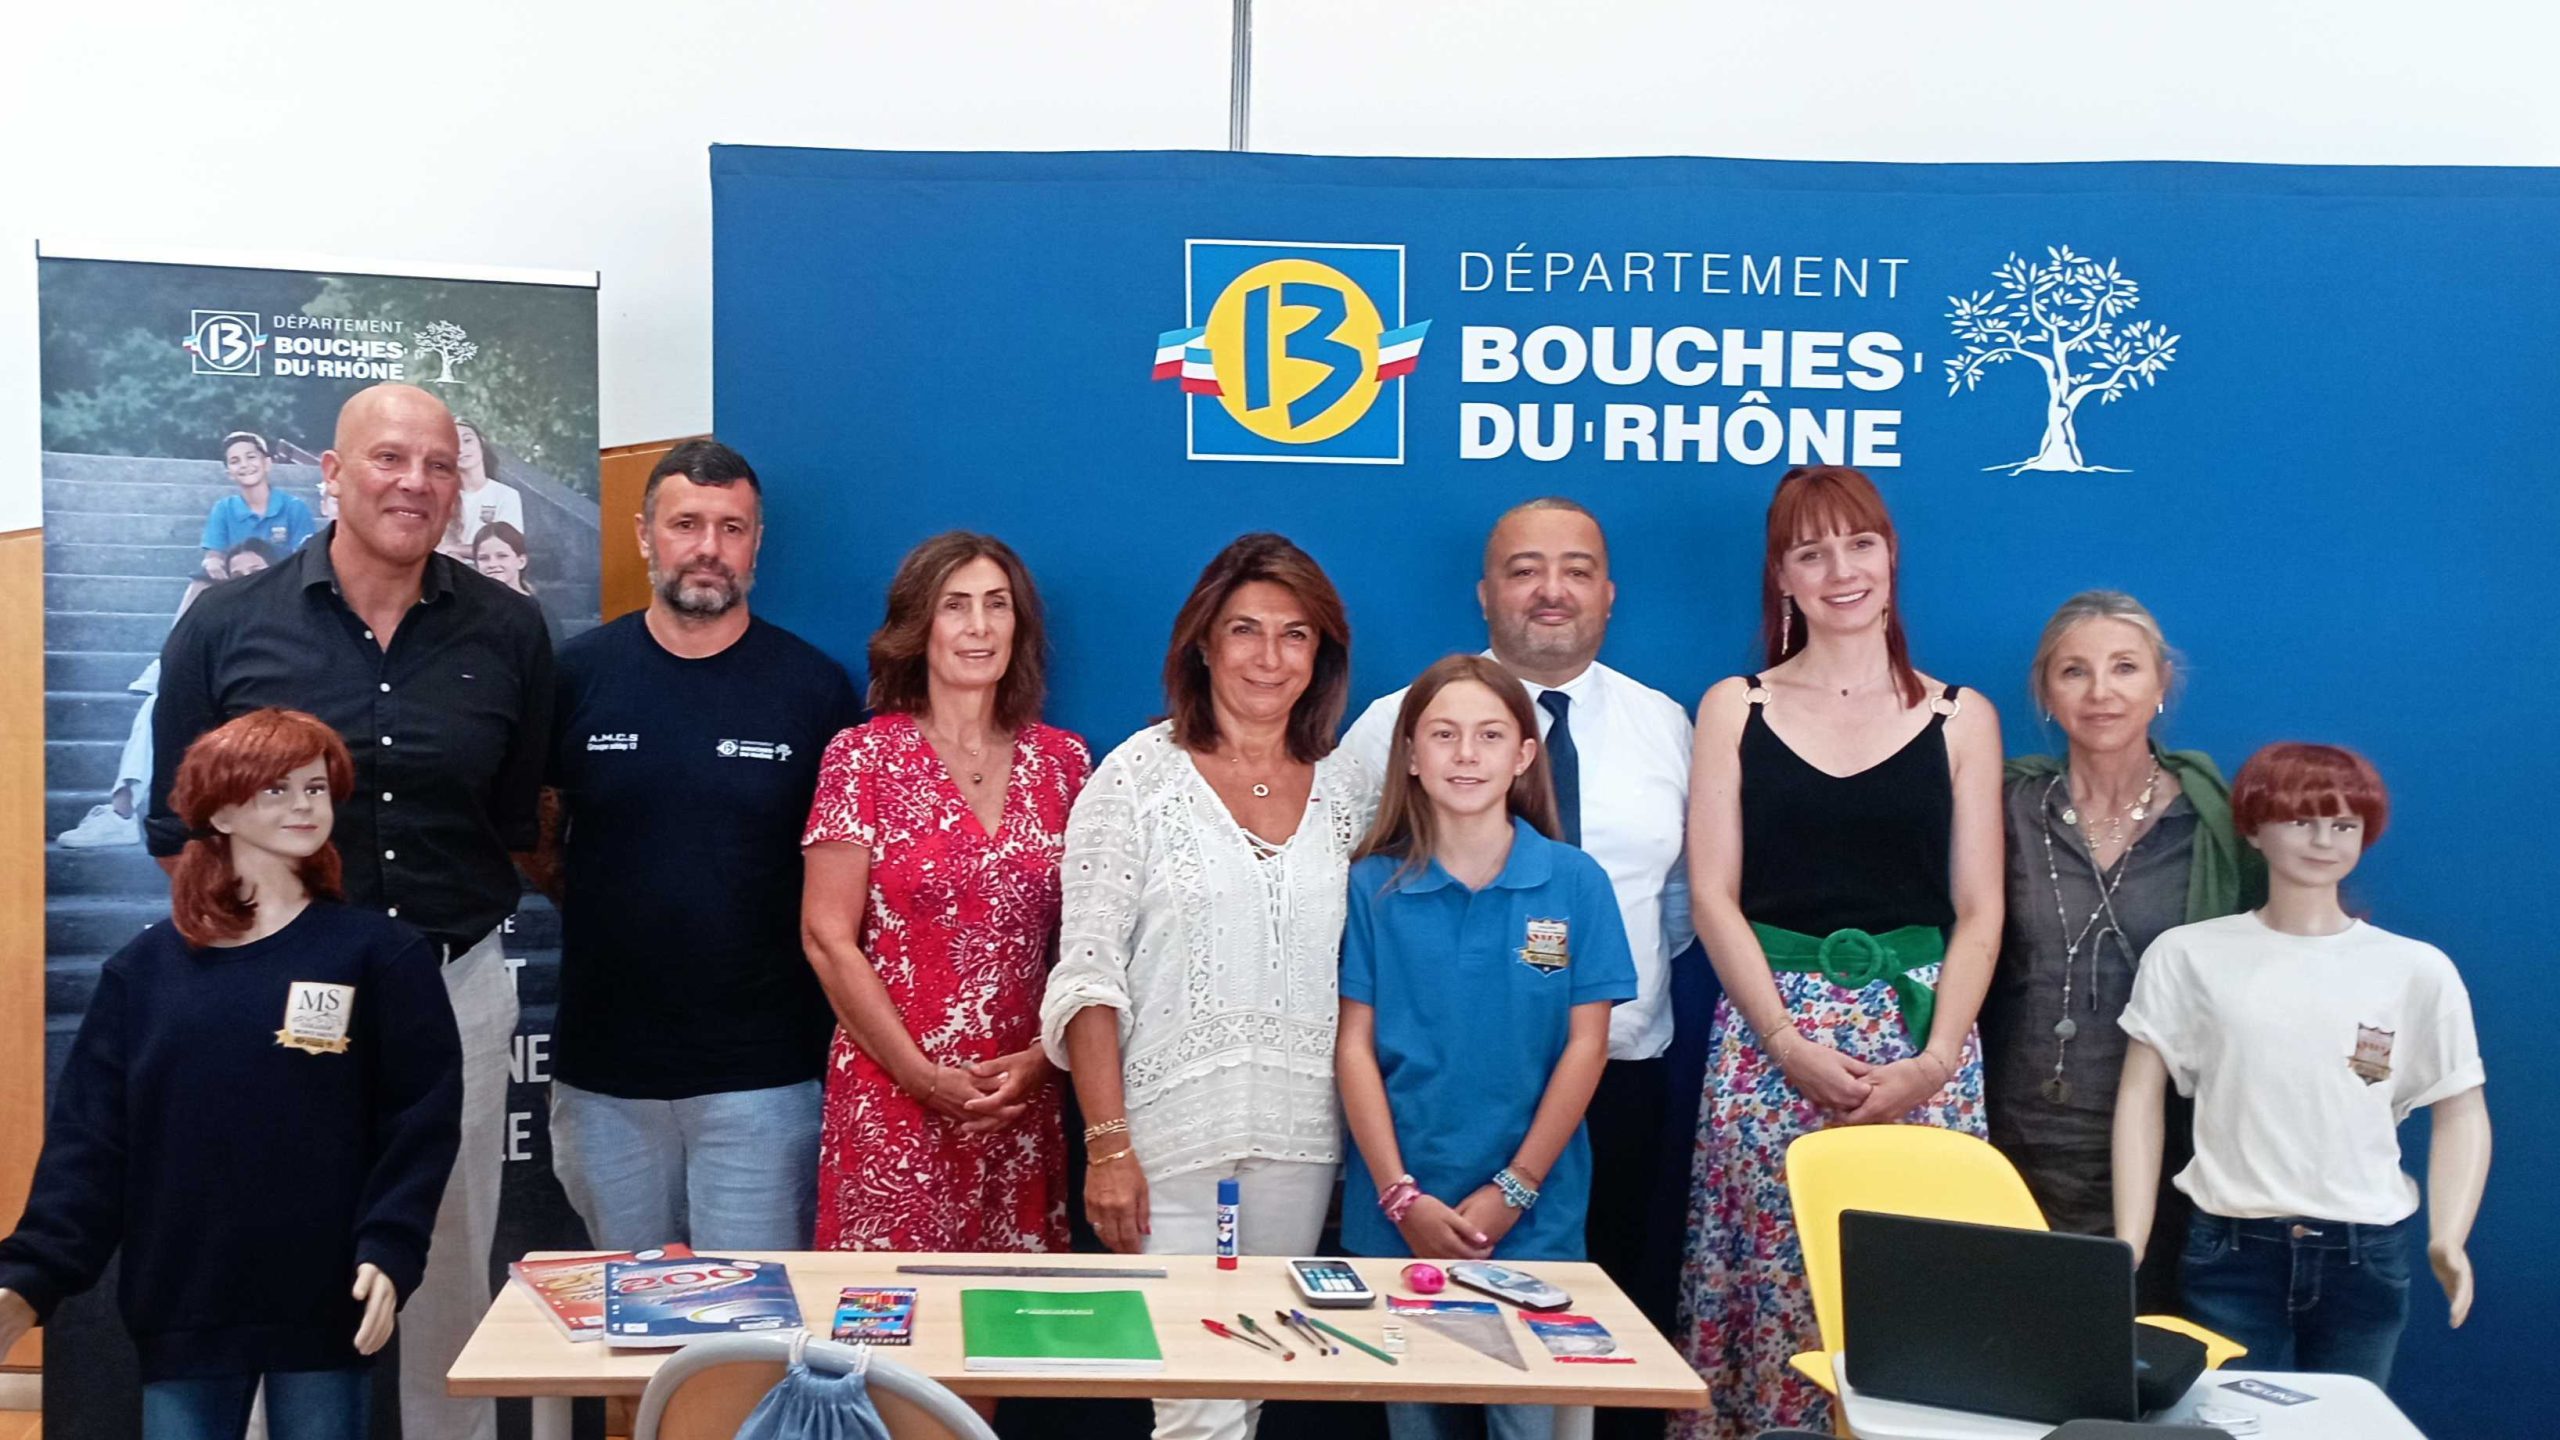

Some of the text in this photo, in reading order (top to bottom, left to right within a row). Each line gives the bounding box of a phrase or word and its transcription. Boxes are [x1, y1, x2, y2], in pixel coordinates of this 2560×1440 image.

[1460, 242, 1909, 299] DÉPARTEMENT
[273, 315, 404, 333] DÉPARTEMENT
[208, 322, 247, 366] 13
[1244, 281, 1365, 431] 13
[297, 988, 341, 1012] MS
[617, 1267, 755, 1295] 200
